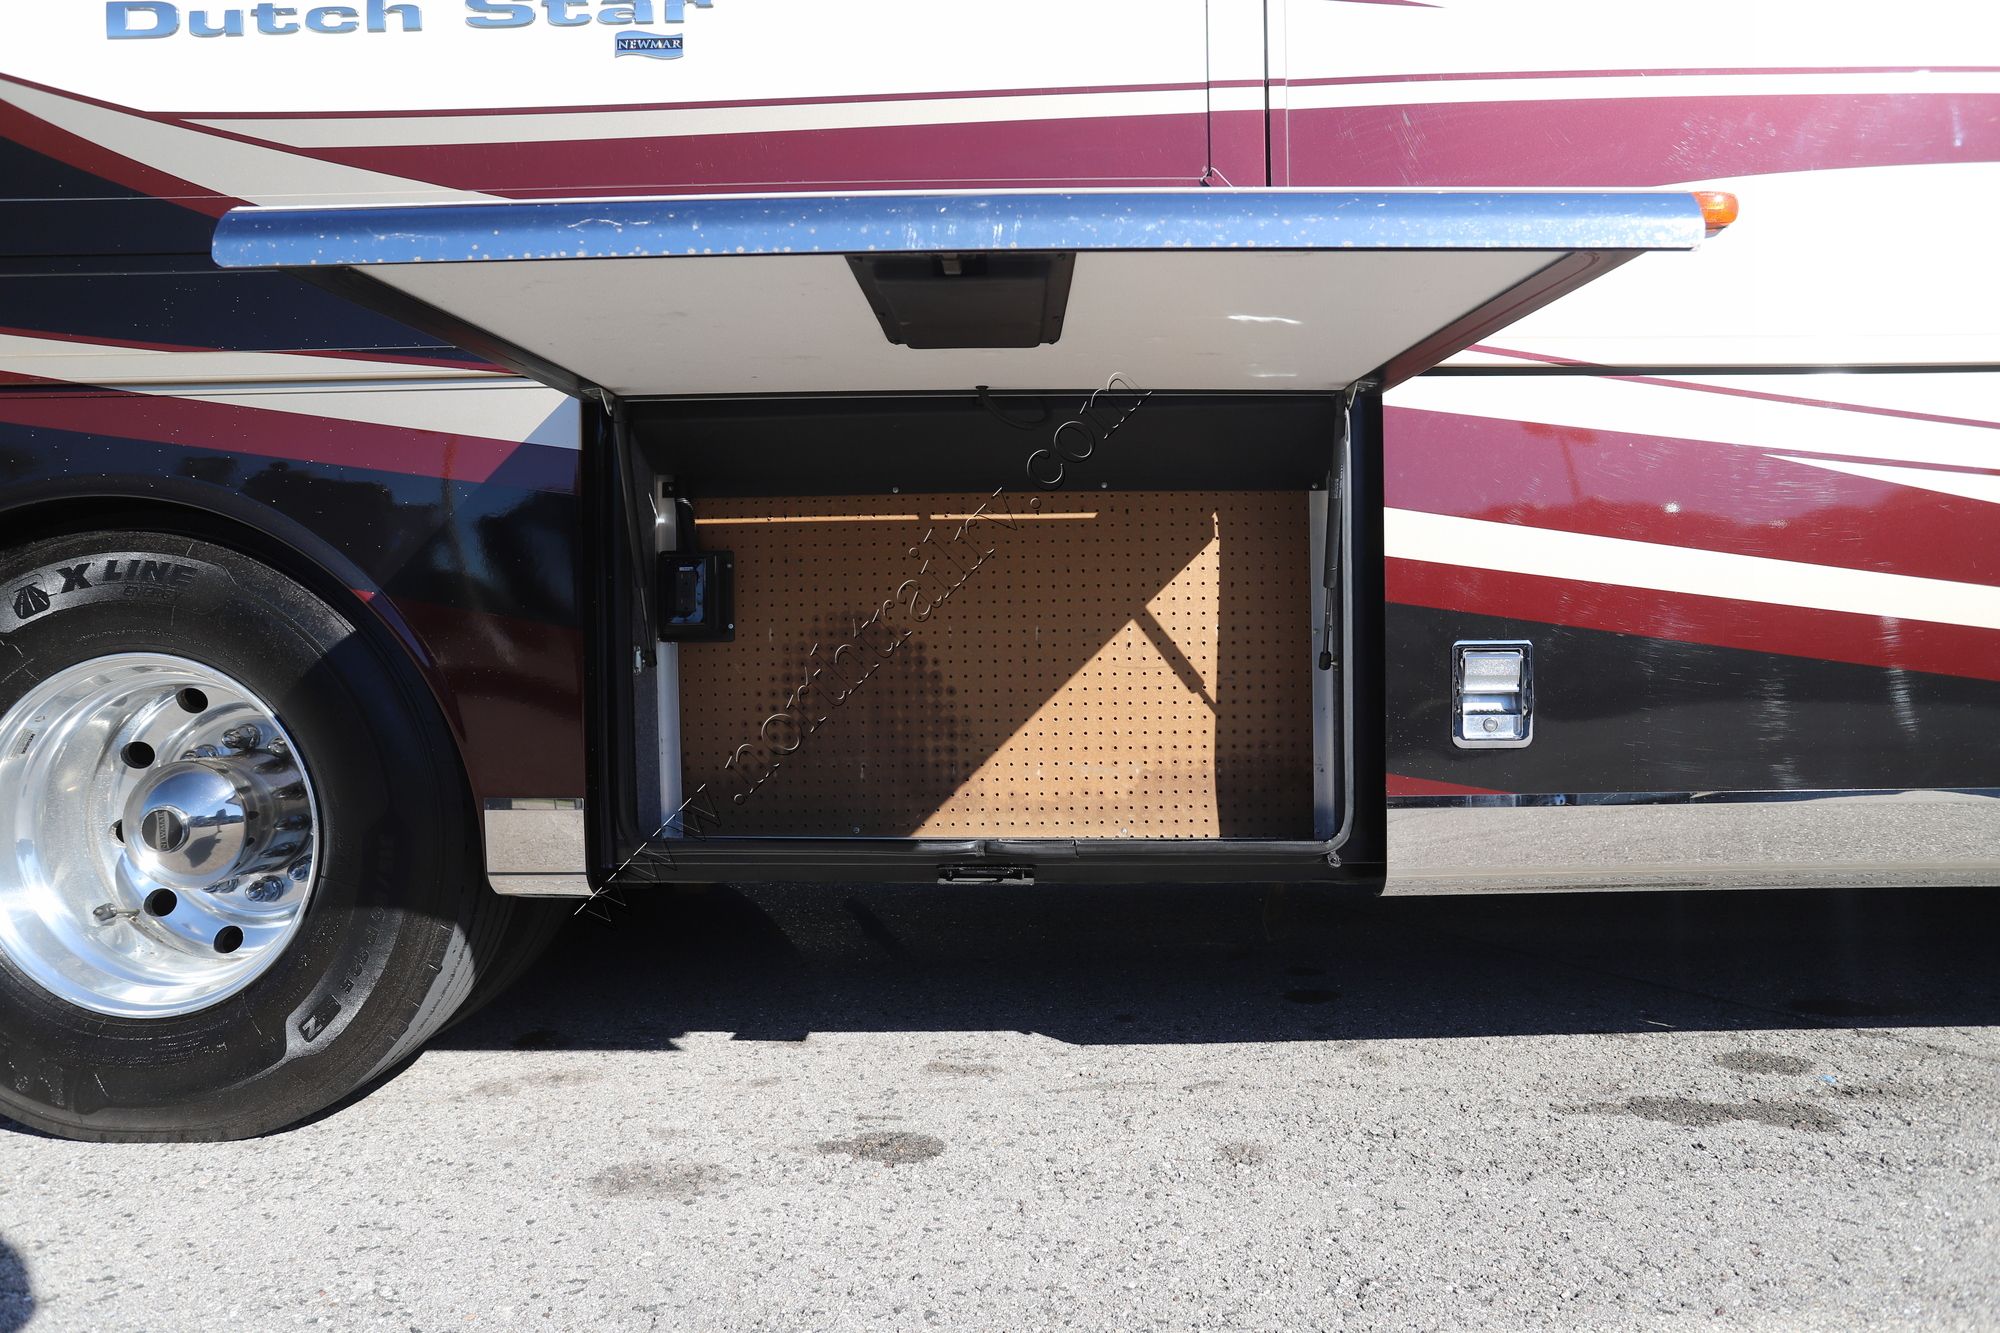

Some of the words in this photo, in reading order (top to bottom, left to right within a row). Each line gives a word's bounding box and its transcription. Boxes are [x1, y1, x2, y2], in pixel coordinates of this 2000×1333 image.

[106, 0, 422, 39] Dutch
[465, 0, 714, 29] Star
[617, 39, 682, 50] NEWMAR
[103, 559, 199, 582] LINE
